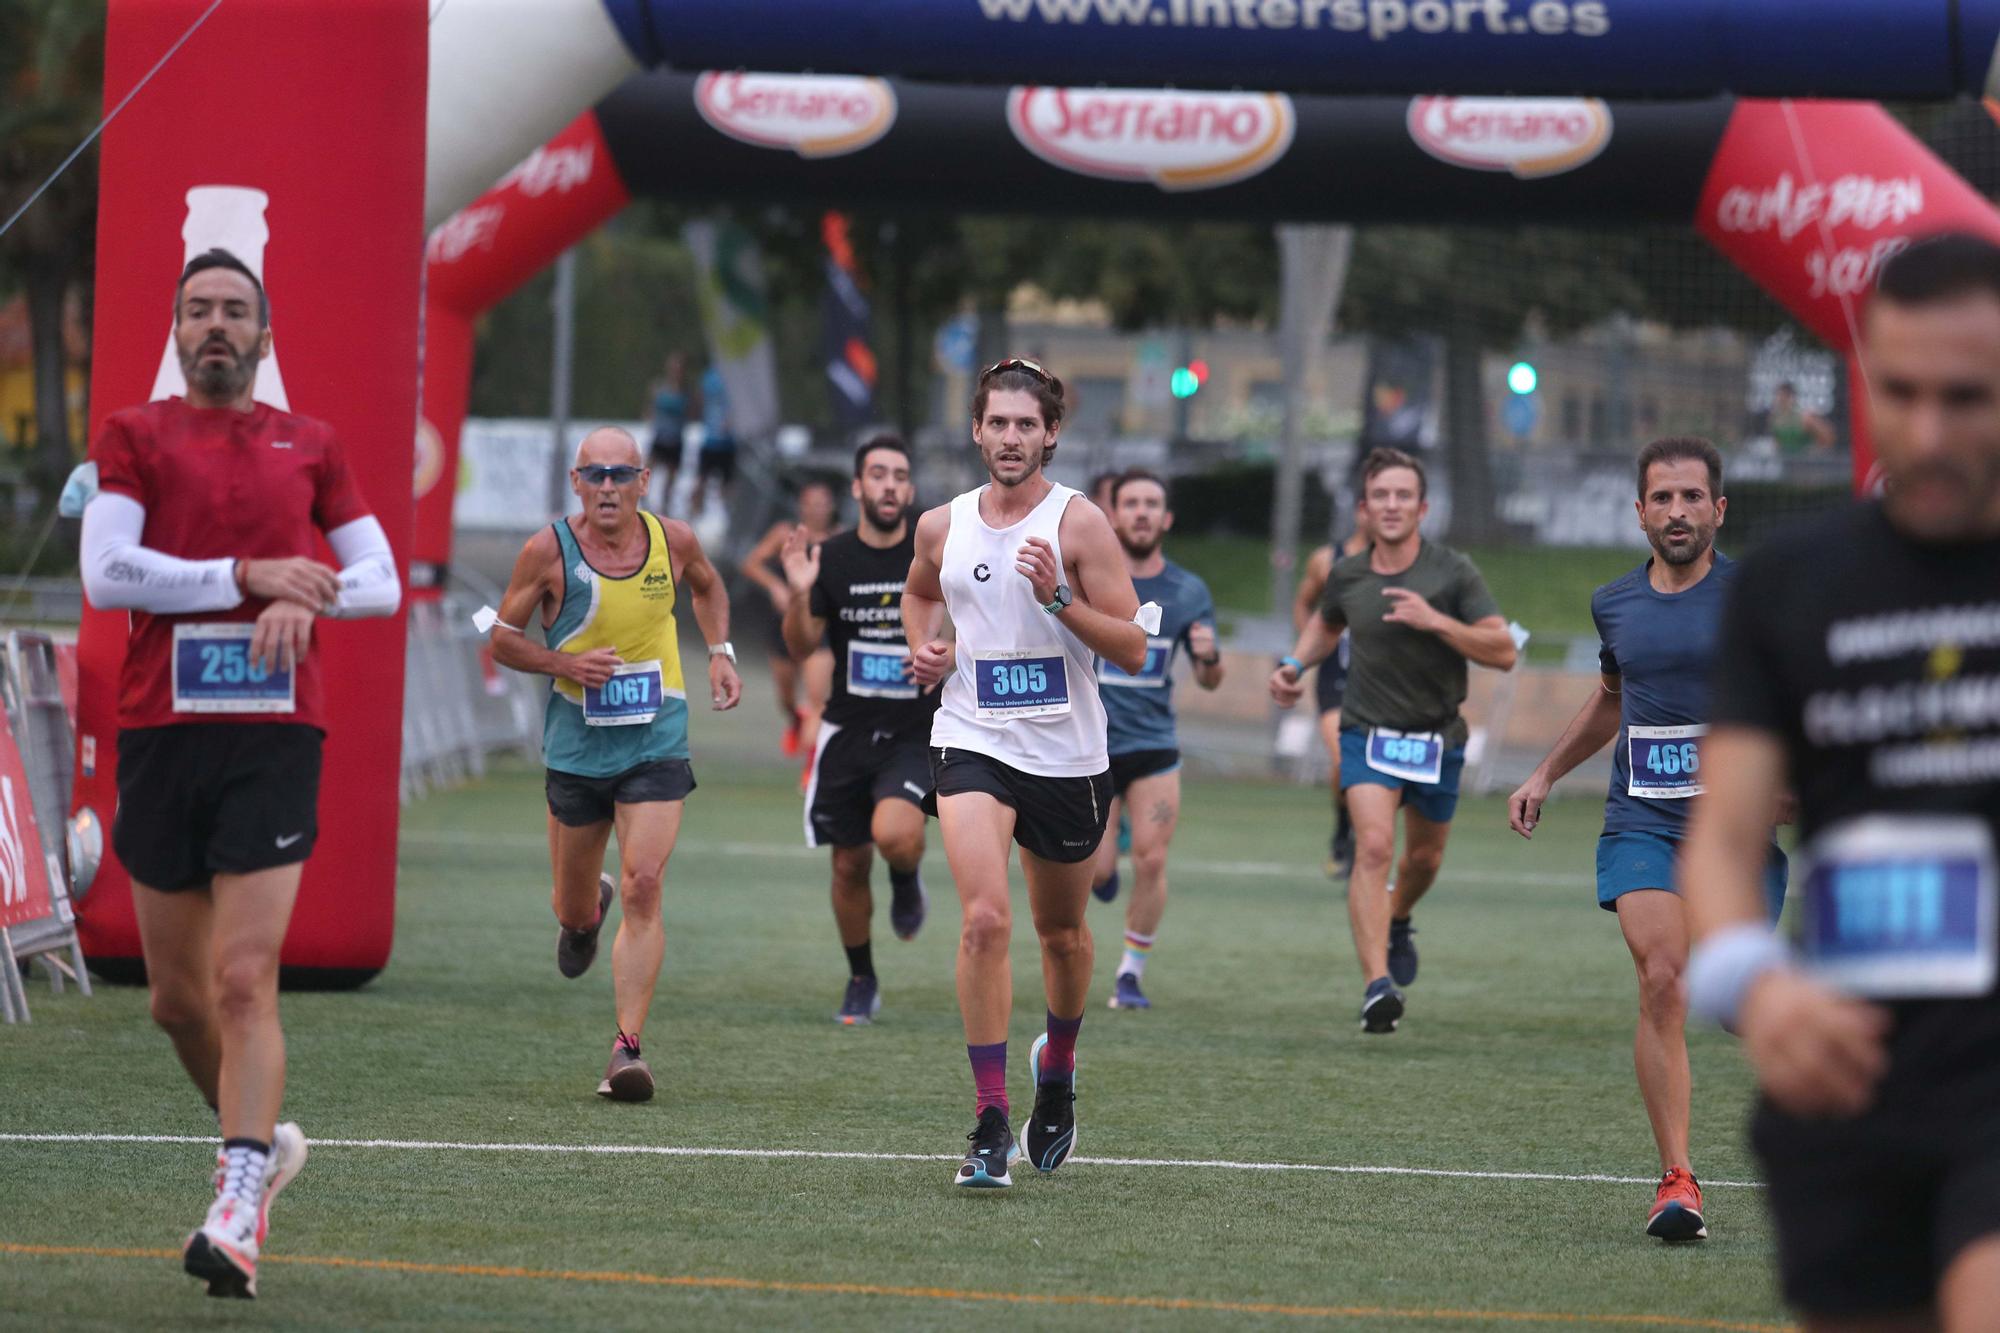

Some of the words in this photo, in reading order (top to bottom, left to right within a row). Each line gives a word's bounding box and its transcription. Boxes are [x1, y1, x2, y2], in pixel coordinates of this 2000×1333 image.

[1048, 87, 1261, 146] Serrano
[600, 676, 650, 706] 1067
[992, 663, 1047, 695] 305
[1646, 743, 1699, 775] 466
